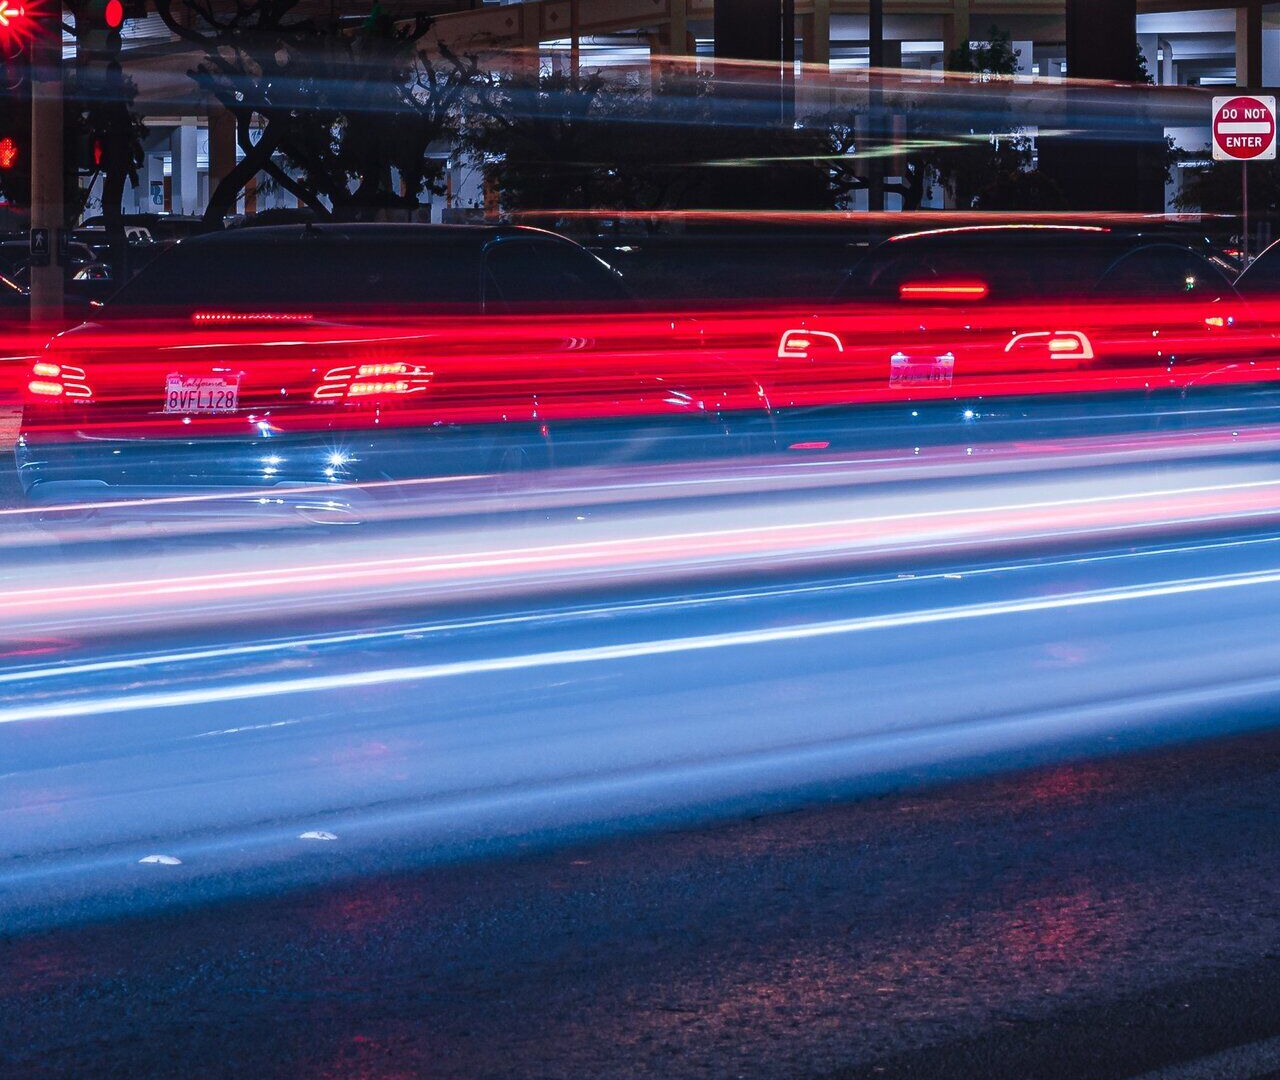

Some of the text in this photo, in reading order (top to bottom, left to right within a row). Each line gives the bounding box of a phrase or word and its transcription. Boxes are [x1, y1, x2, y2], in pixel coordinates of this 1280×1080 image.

[1222, 108, 1267, 119] DO NOT
[1226, 137, 1262, 148] ENTER
[168, 390, 234, 409] 8VFL128
